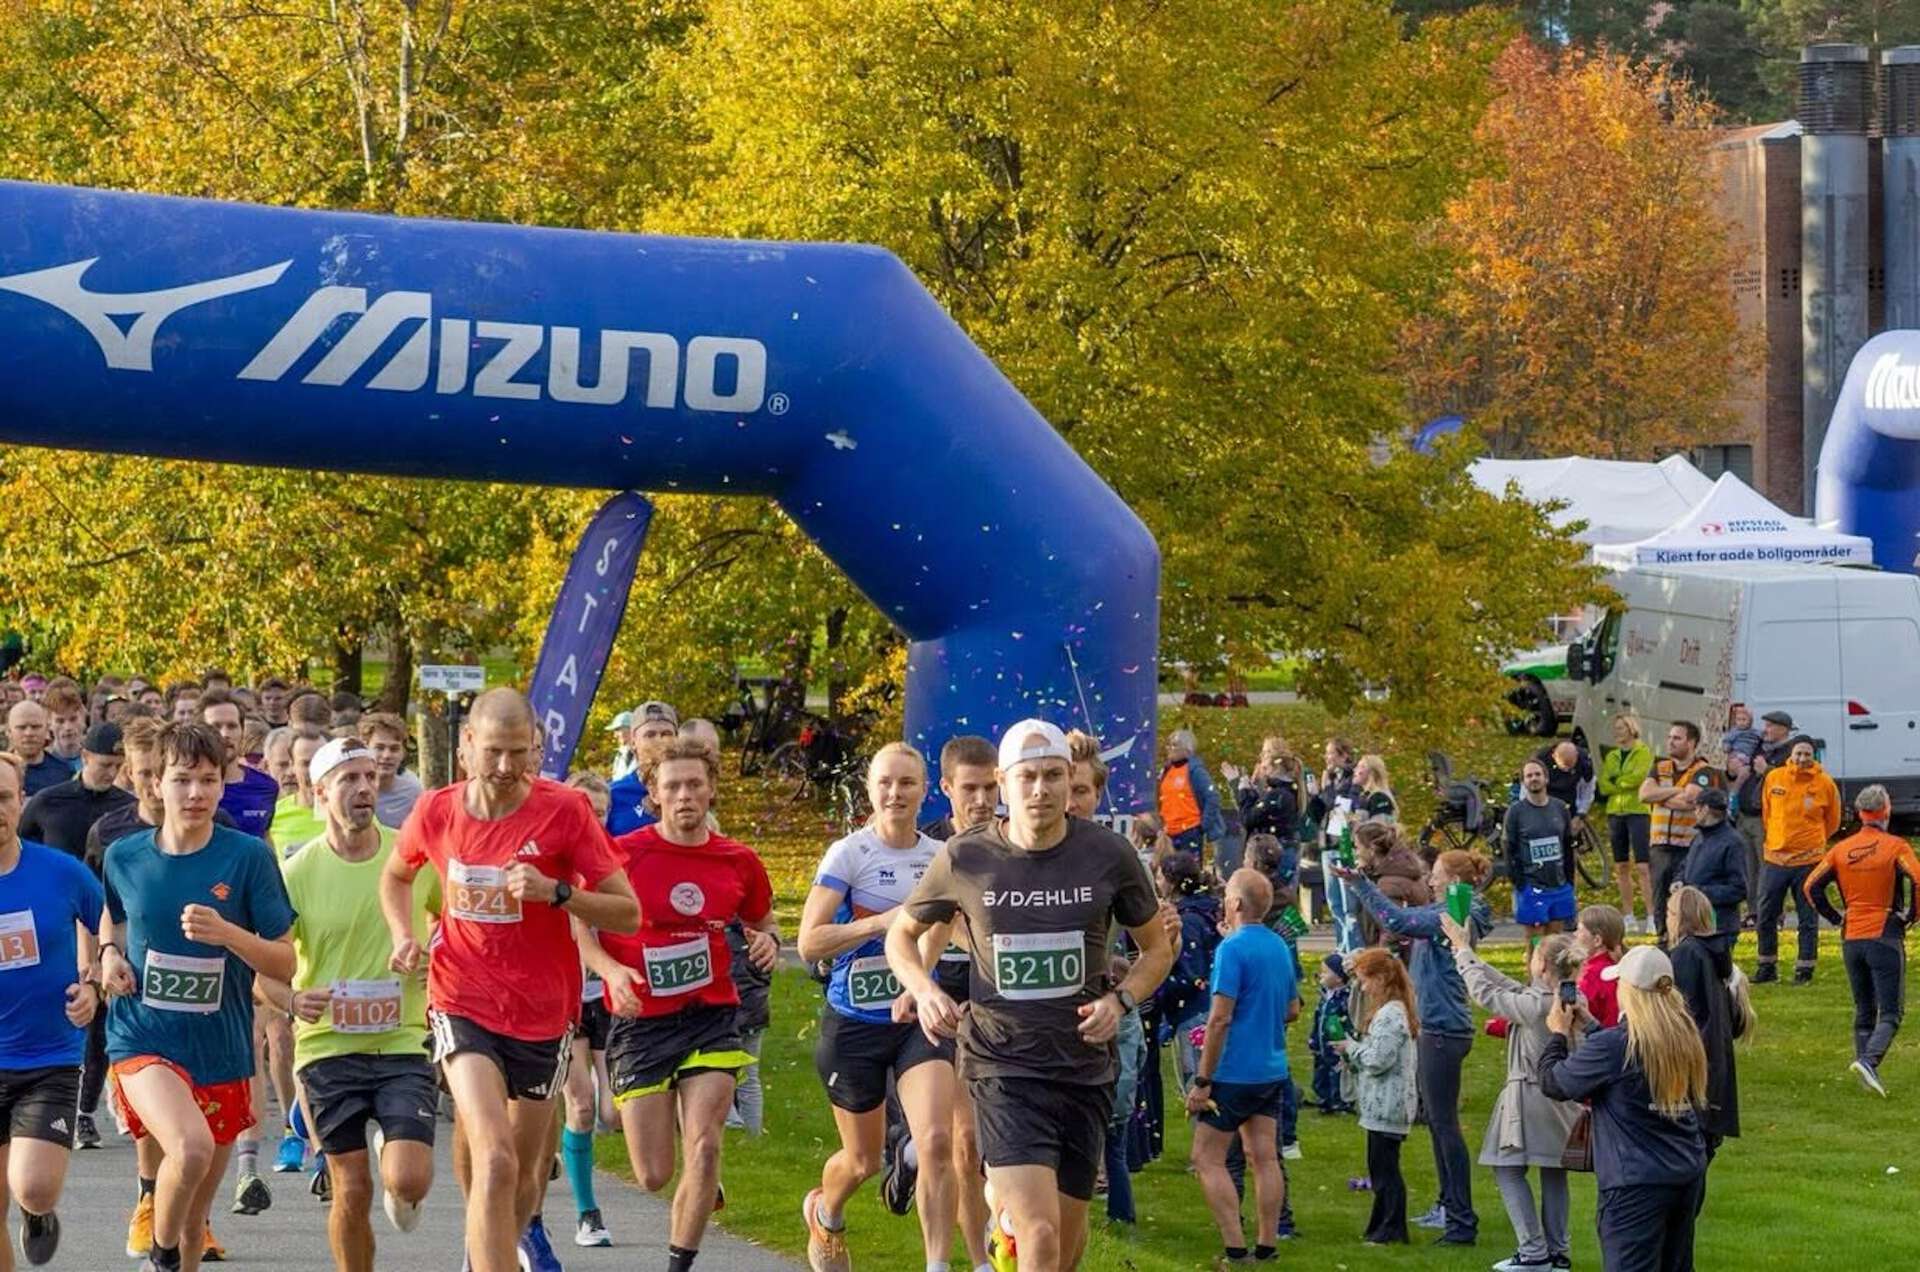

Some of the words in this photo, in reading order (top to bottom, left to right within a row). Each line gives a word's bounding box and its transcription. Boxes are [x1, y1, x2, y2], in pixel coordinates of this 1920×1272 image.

[1696, 549, 1716, 562] for
[538, 537, 618, 780] STAR
[456, 887, 507, 914] 824
[147, 969, 219, 999] 3227
[651, 954, 708, 985] 3129
[1000, 954, 1080, 985] 3210
[334, 1001, 399, 1025] 1102
